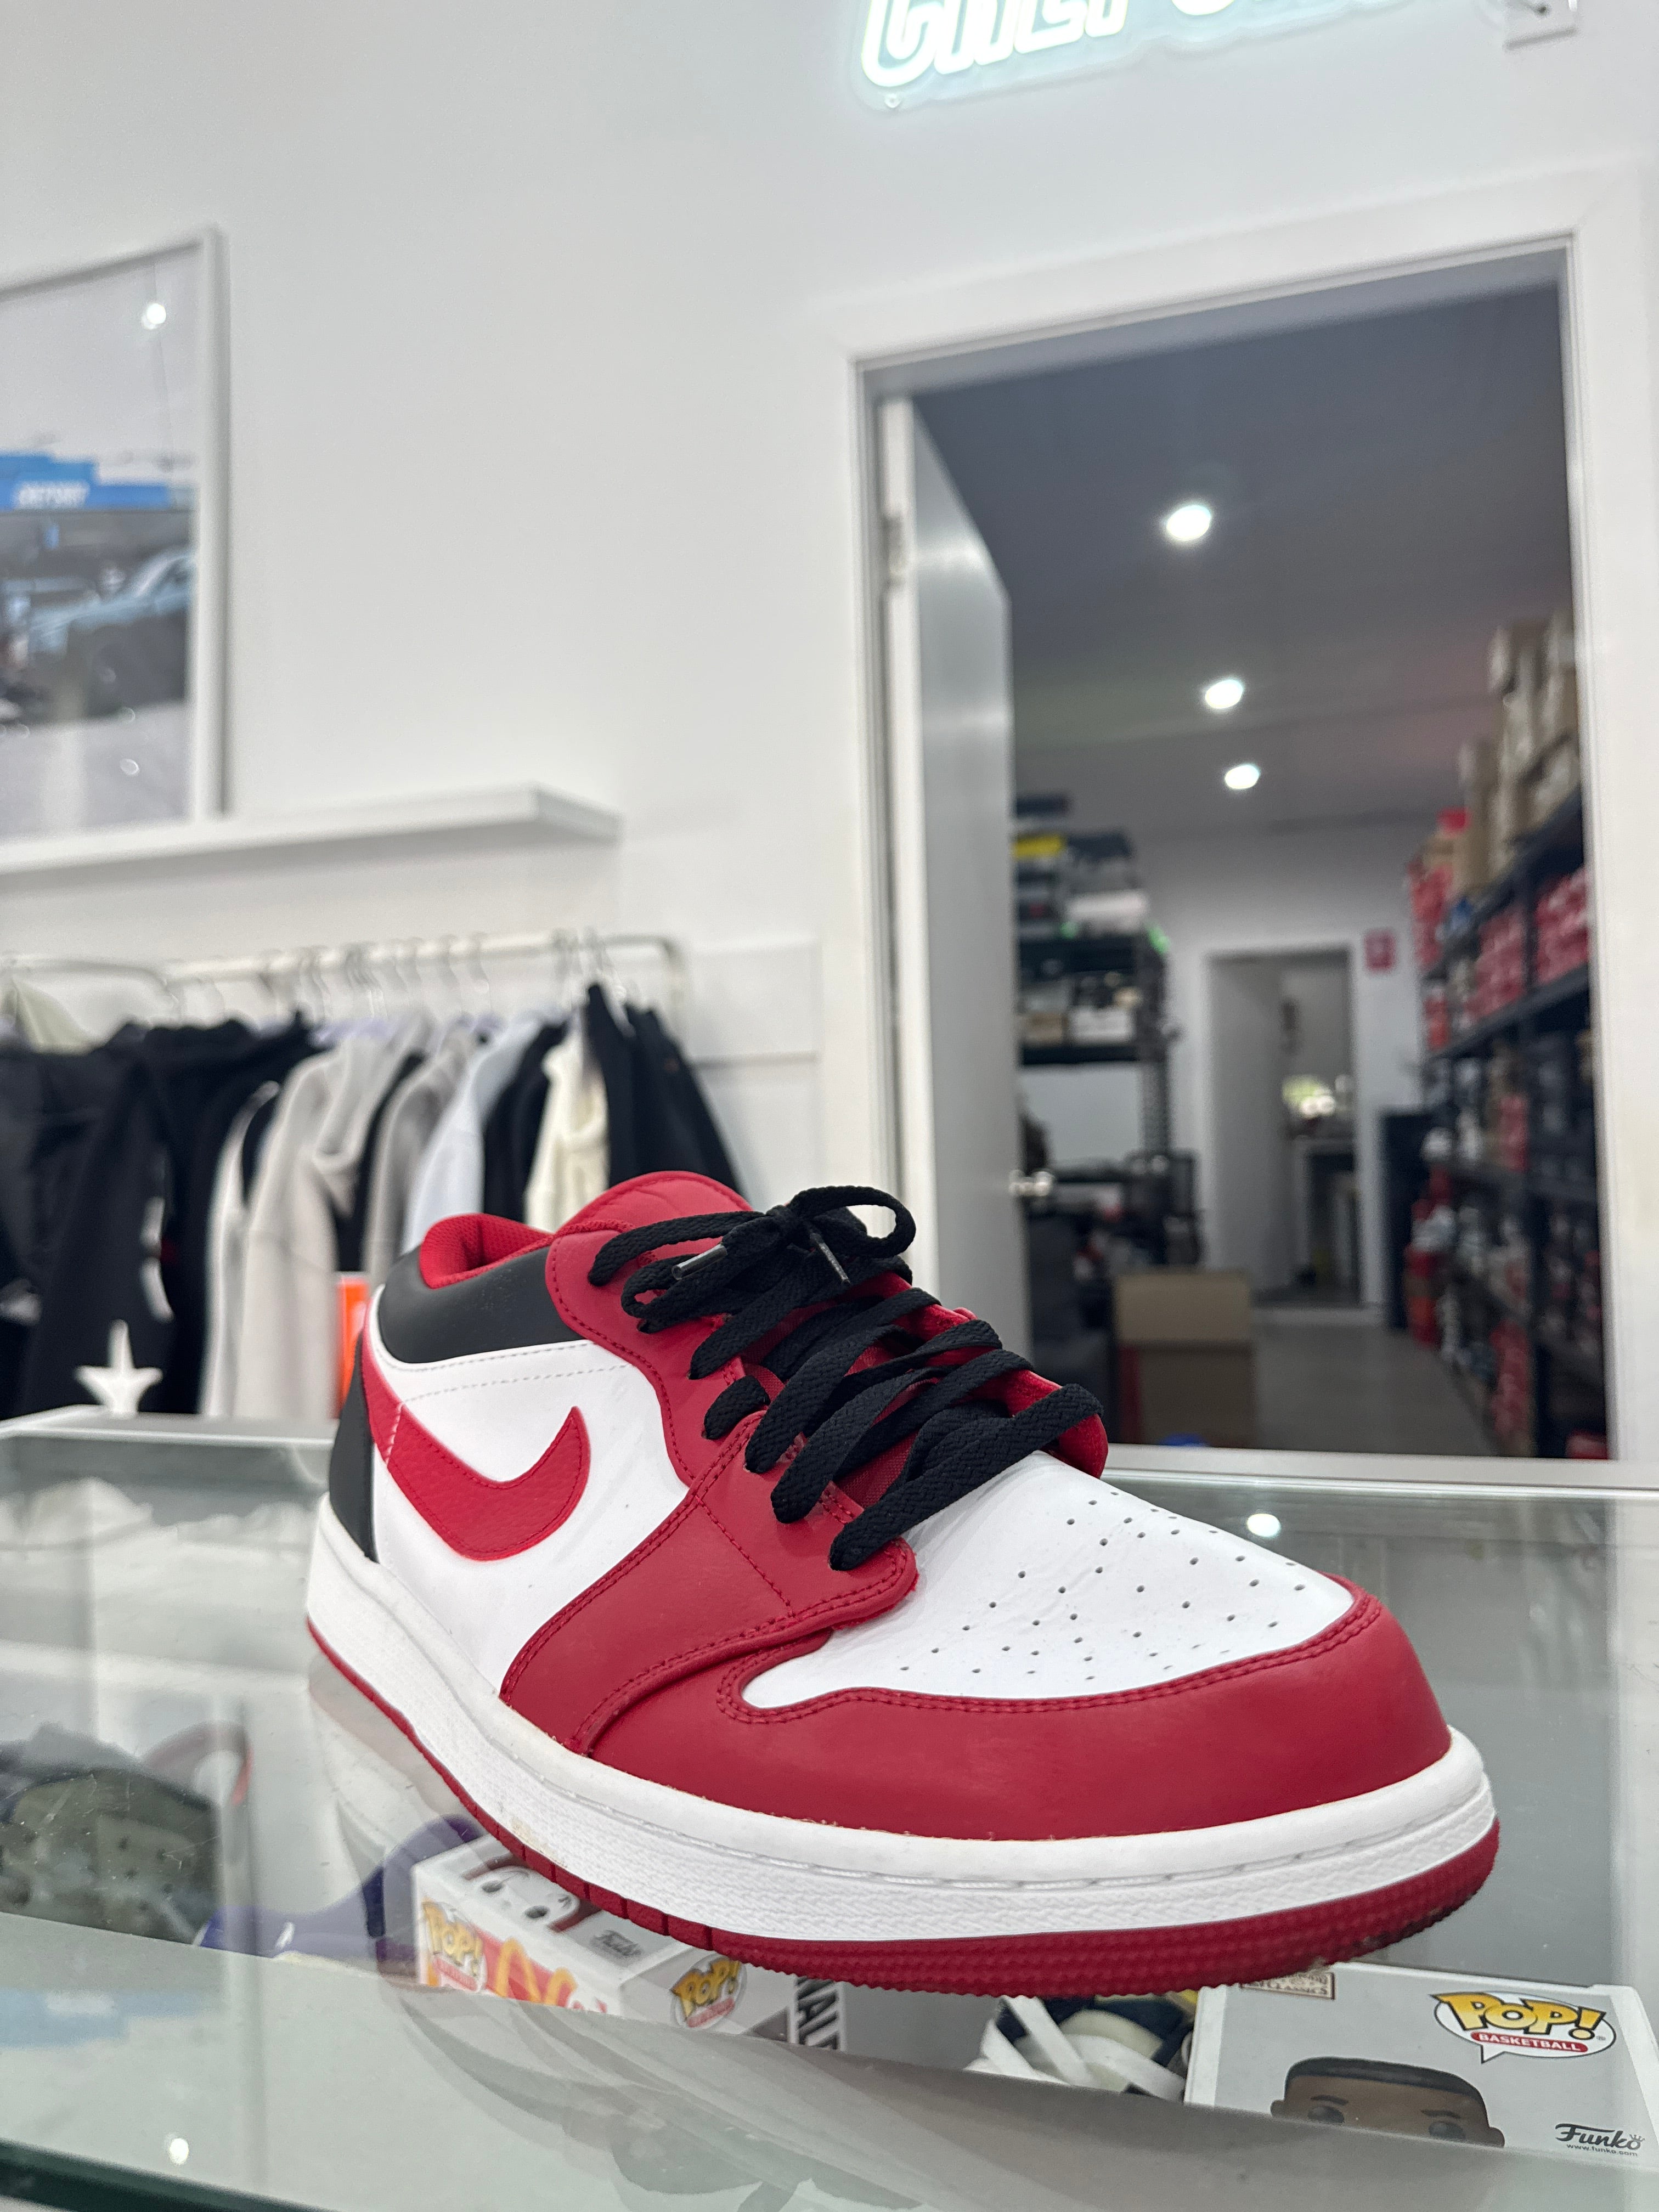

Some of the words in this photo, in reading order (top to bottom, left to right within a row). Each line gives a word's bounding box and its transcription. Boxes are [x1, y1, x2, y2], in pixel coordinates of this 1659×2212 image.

[669, 1956, 741, 2021] POP!
[1429, 1992, 1606, 2040] POP!
[1479, 2032, 1581, 2052] BASKETBALL
[1555, 2123, 1642, 2150] Funko
[1566, 2143, 1638, 2157] www.funko.com
